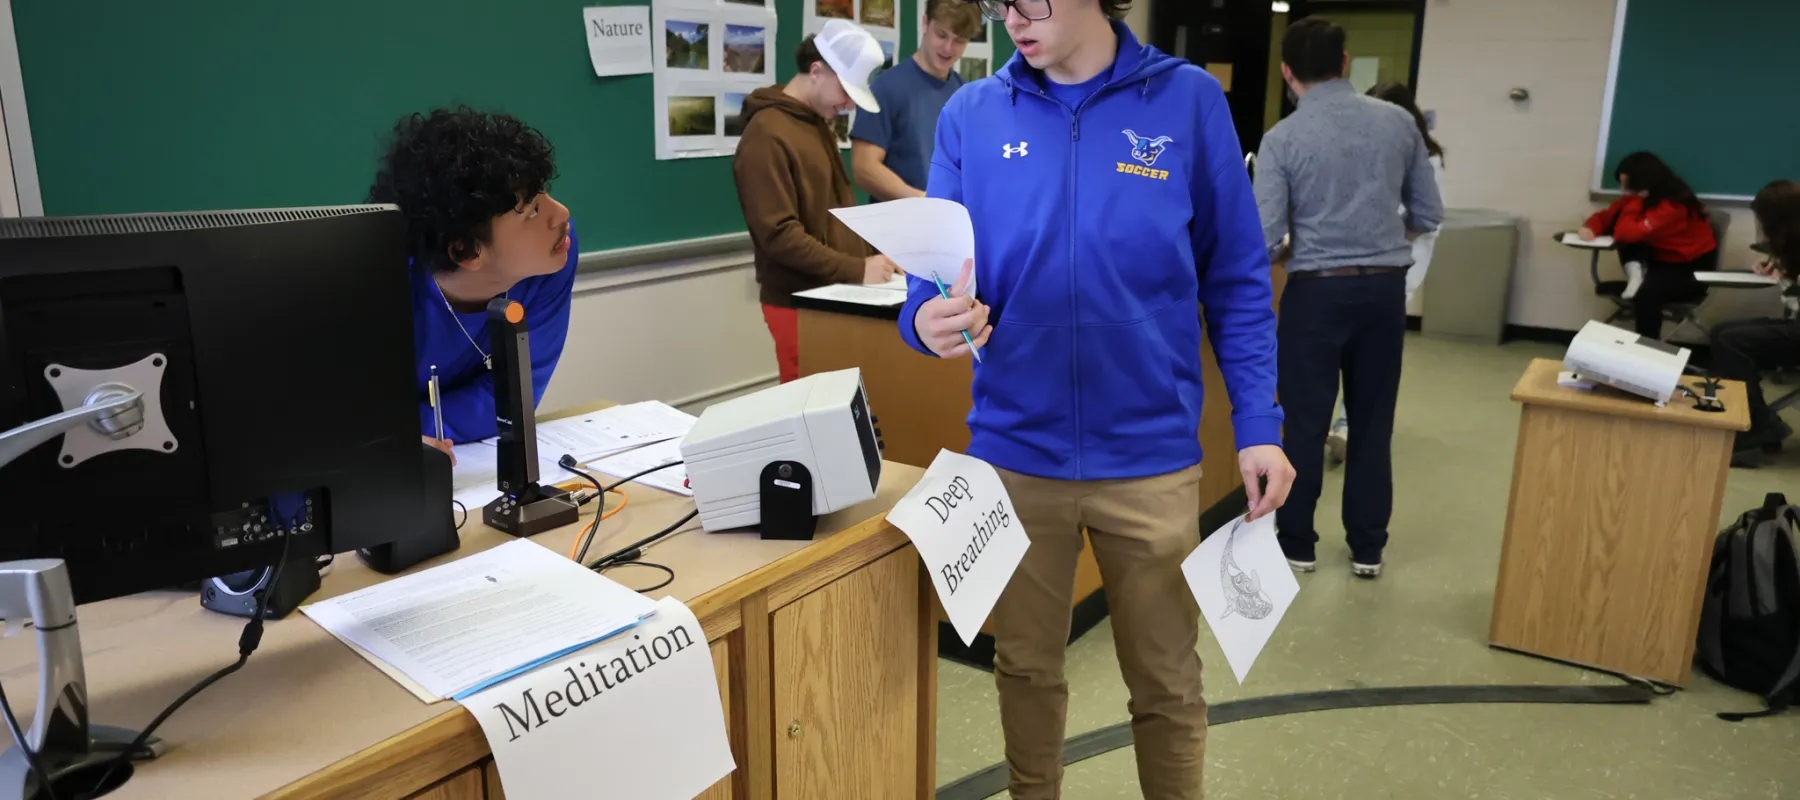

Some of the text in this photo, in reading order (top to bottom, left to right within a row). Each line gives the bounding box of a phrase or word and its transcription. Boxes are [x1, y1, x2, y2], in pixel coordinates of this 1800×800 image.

[592, 18, 643, 38] Nature
[1116, 162, 1169, 181] SOCCER
[925, 475, 973, 525] Deep
[940, 499, 1010, 596] Breathing
[493, 624, 695, 742] Meditation
